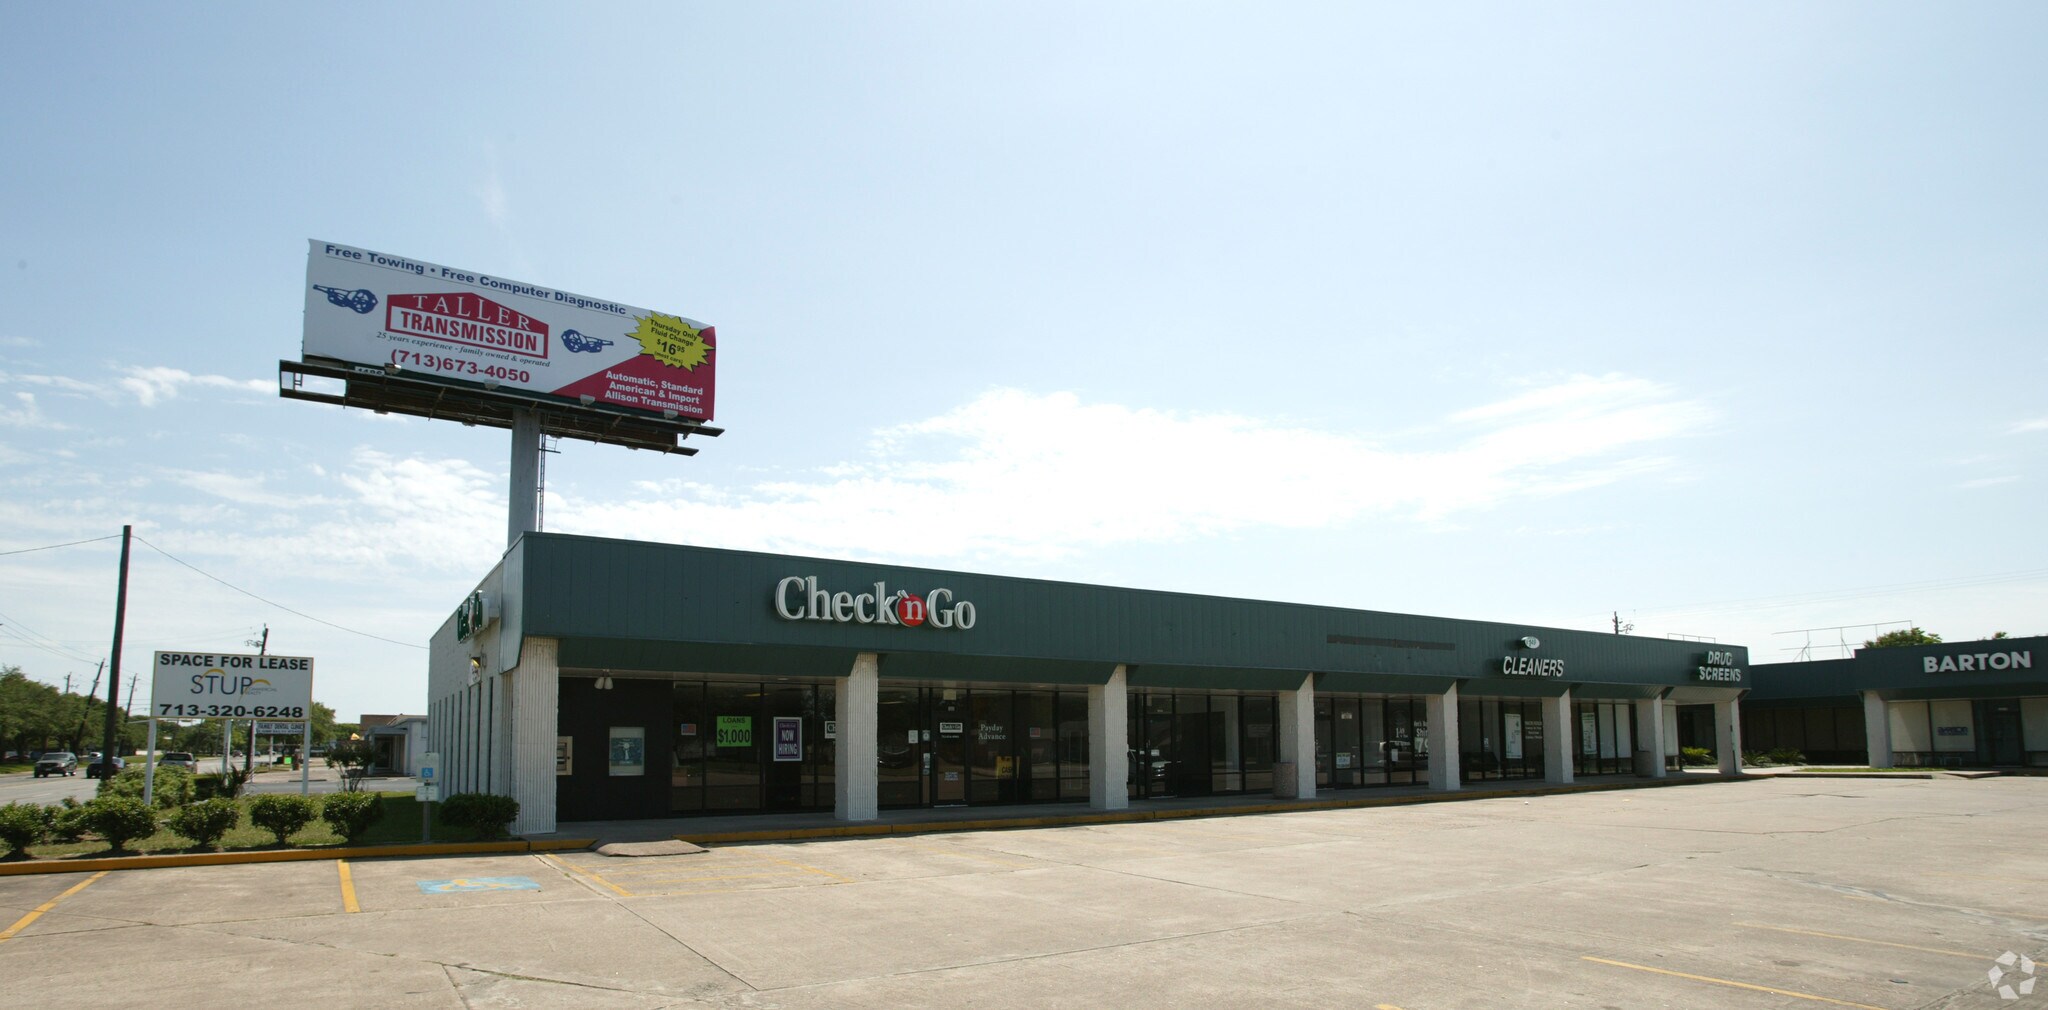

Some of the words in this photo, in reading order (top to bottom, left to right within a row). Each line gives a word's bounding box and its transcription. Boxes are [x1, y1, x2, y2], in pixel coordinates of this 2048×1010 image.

[325, 244, 362, 260] Free
[367, 252, 424, 275] Towing
[441, 267, 475, 283] Free
[480, 276, 550, 299] Computer
[554, 291, 627, 315] Diagnostic
[413, 294, 531, 331] TALLER
[400, 310, 537, 352] TRANSMISSION
[650, 318, 681, 337] Thursday
[682, 328, 698, 342] Only
[650, 326, 668, 339] Fluid
[669, 332, 694, 347] Change
[376, 331, 387, 339] 25
[389, 334, 410, 346] years
[412, 337, 453, 351] experience
[458, 344, 484, 358] family
[485, 351, 509, 361] owned
[511, 353, 517, 362] &
[518, 357, 551, 368] operated
[391, 348, 530, 383] (713)673-4050
[605, 370, 659, 389] Automatic,
[661, 380, 703, 396] Standard
[609, 381, 656, 397] American
[658, 388, 666, 398] &
[668, 391, 700, 405] Import
[605, 389, 639, 404] Allison
[641, 397, 703, 415] Transmission
[775, 575, 898, 625] Check
[926, 588, 976, 630] Go
[160, 653, 215, 668] SPACE
[220, 655, 253, 669] FOR
[259, 657, 309, 671] LEASE
[1502, 655, 1565, 678] CLEANERS
[1707, 650, 1733, 666] DRUG
[1923, 650, 2032, 674] BARTON
[1698, 665, 1742, 682] SCREENS
[159, 703, 304, 718] 713-320-6248
[722, 716, 746, 724] LOANS
[718, 728, 751, 745] $1,000
[781, 730, 795, 741] NOW
[980, 723, 1003, 734] Payday
[778, 743, 798, 755] HIRING
